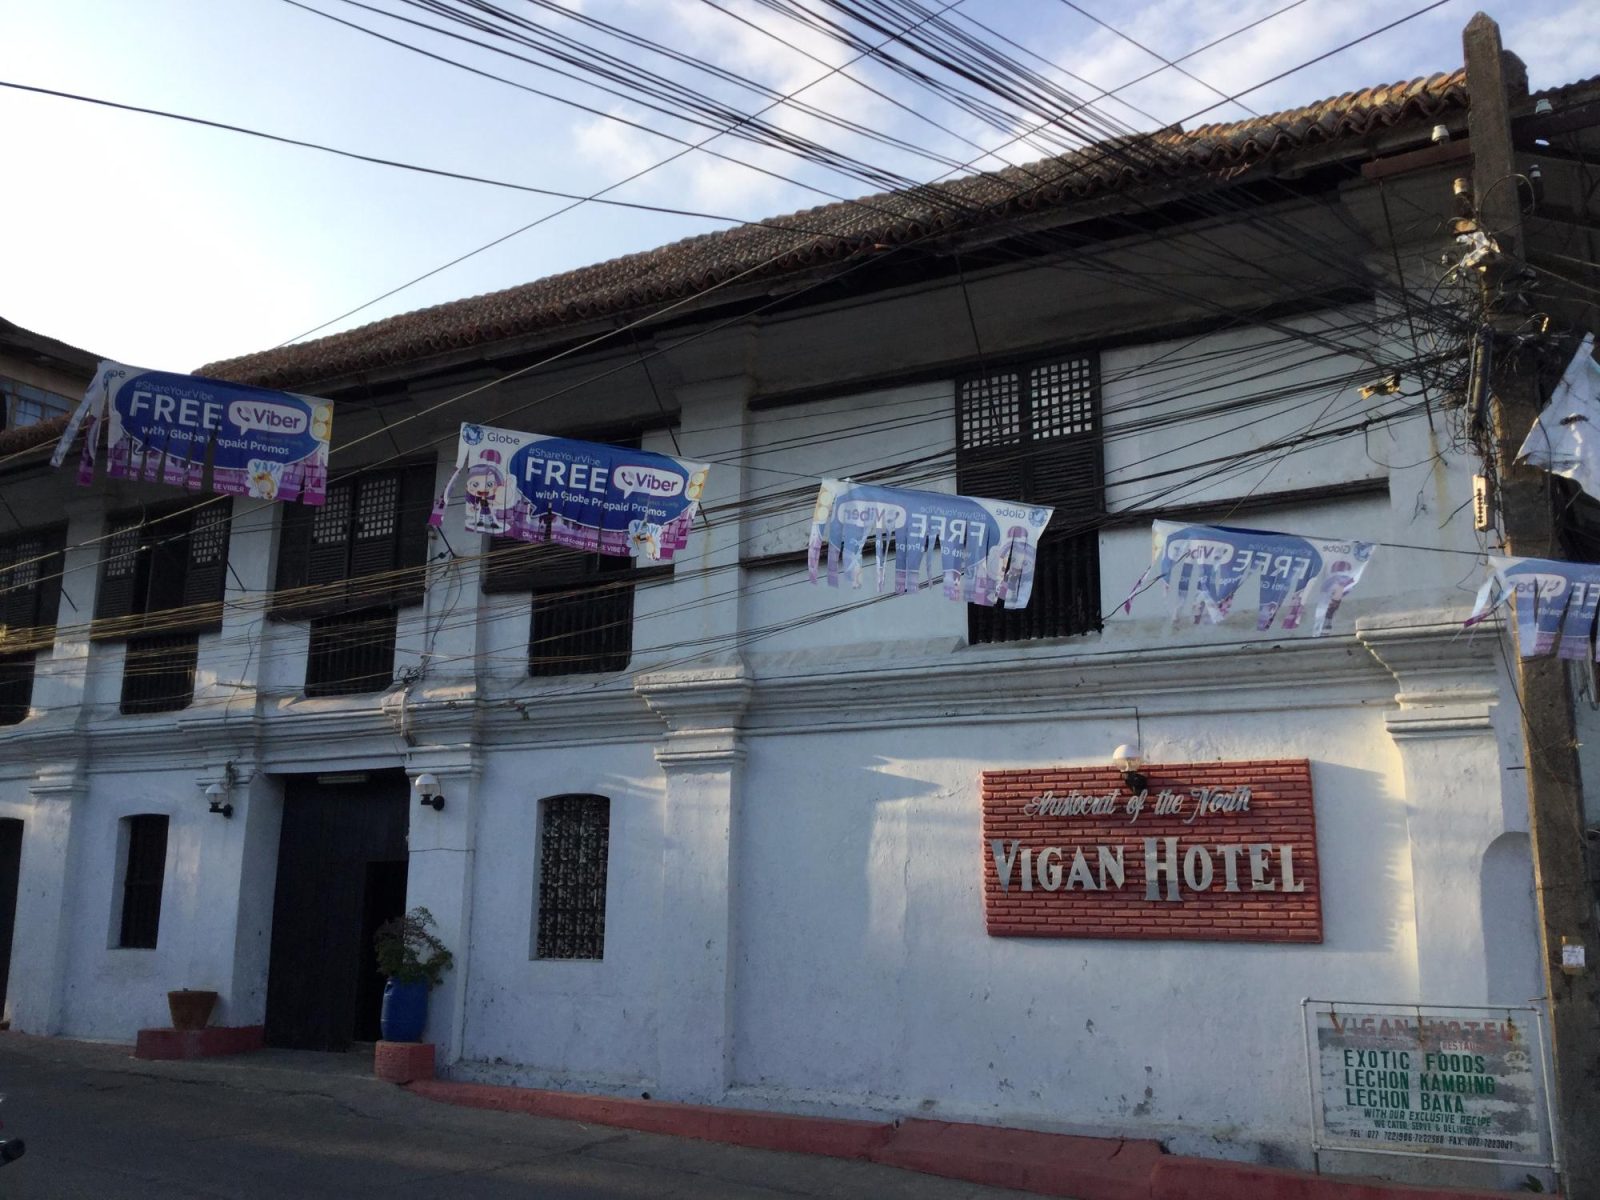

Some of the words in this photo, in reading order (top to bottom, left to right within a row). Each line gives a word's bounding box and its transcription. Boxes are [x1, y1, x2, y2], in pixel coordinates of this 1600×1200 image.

[135, 380, 214, 400] #ShareYourVibe
[129, 391, 224, 431] FREE
[253, 408, 301, 429] Viber
[250, 436, 290, 455] Promos
[487, 432, 520, 445] Globe
[528, 447, 600, 465] #ShareYourVibe
[525, 457, 609, 495] FREE
[636, 473, 678, 493] Viber
[562, 491, 590, 504] Globe
[591, 497, 629, 512] Prepaid
[631, 502, 667, 518] Promos
[1024, 788, 1120, 817] Aristocrat
[1126, 788, 1147, 824] of
[1154, 788, 1184, 815] the
[1183, 785, 1252, 825] North
[1344, 1050, 1411, 1070] EXOTIC
[1425, 1053, 1486, 1074] FOODS
[1345, 1069, 1410, 1090] LECHON
[1420, 1073, 1496, 1095] KAMBING
[1346, 1088, 1410, 1110] LECHON
[1420, 1093, 1465, 1114] BAKA
[1364, 1107, 1387, 1119] WITH
[1389, 1109, 1405, 1120] OUR
[1409, 1110, 1455, 1124] EXCLUSIVE
[1460, 1113, 1491, 1127] RECIPE
